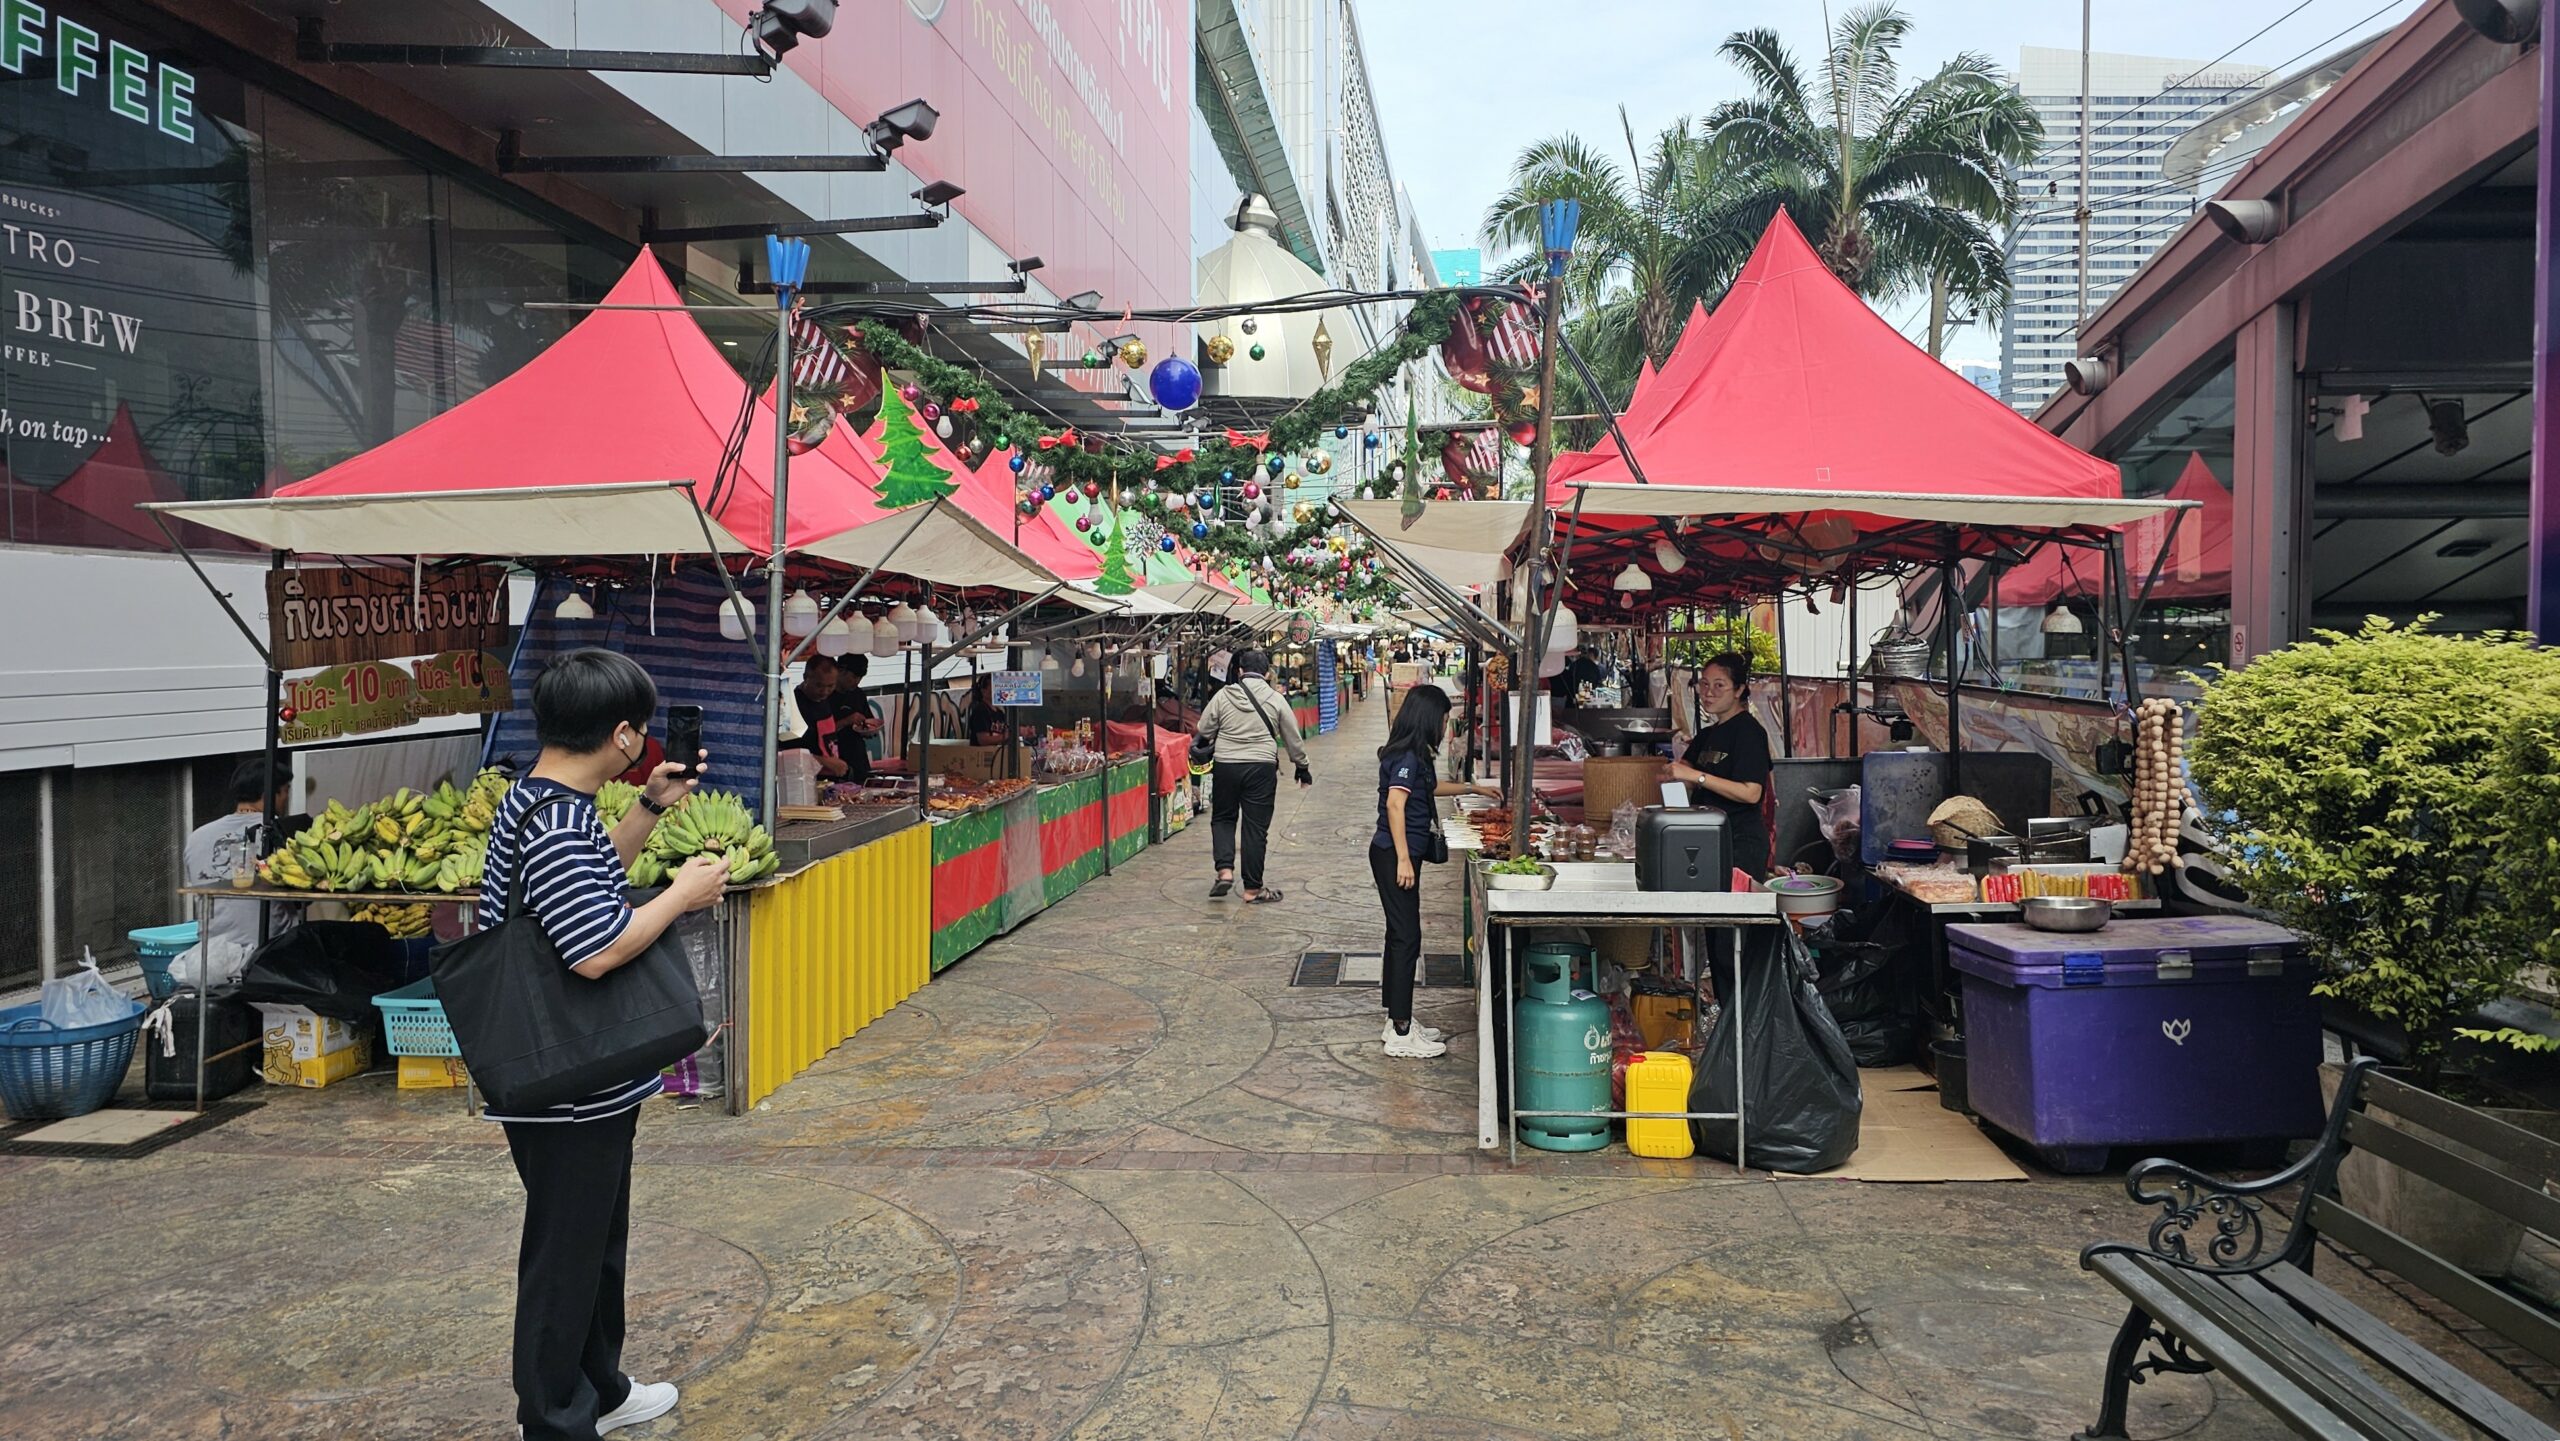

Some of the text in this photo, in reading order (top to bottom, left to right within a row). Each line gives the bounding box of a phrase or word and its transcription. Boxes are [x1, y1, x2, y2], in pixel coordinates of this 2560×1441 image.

[14, 289, 143, 354] BREW
[19, 418, 47, 439] on
[287, 664, 411, 713] ไม้ละ 10 บาท
[412, 660, 452, 691] ไม้ละ
[321, 723, 329, 737] 2
